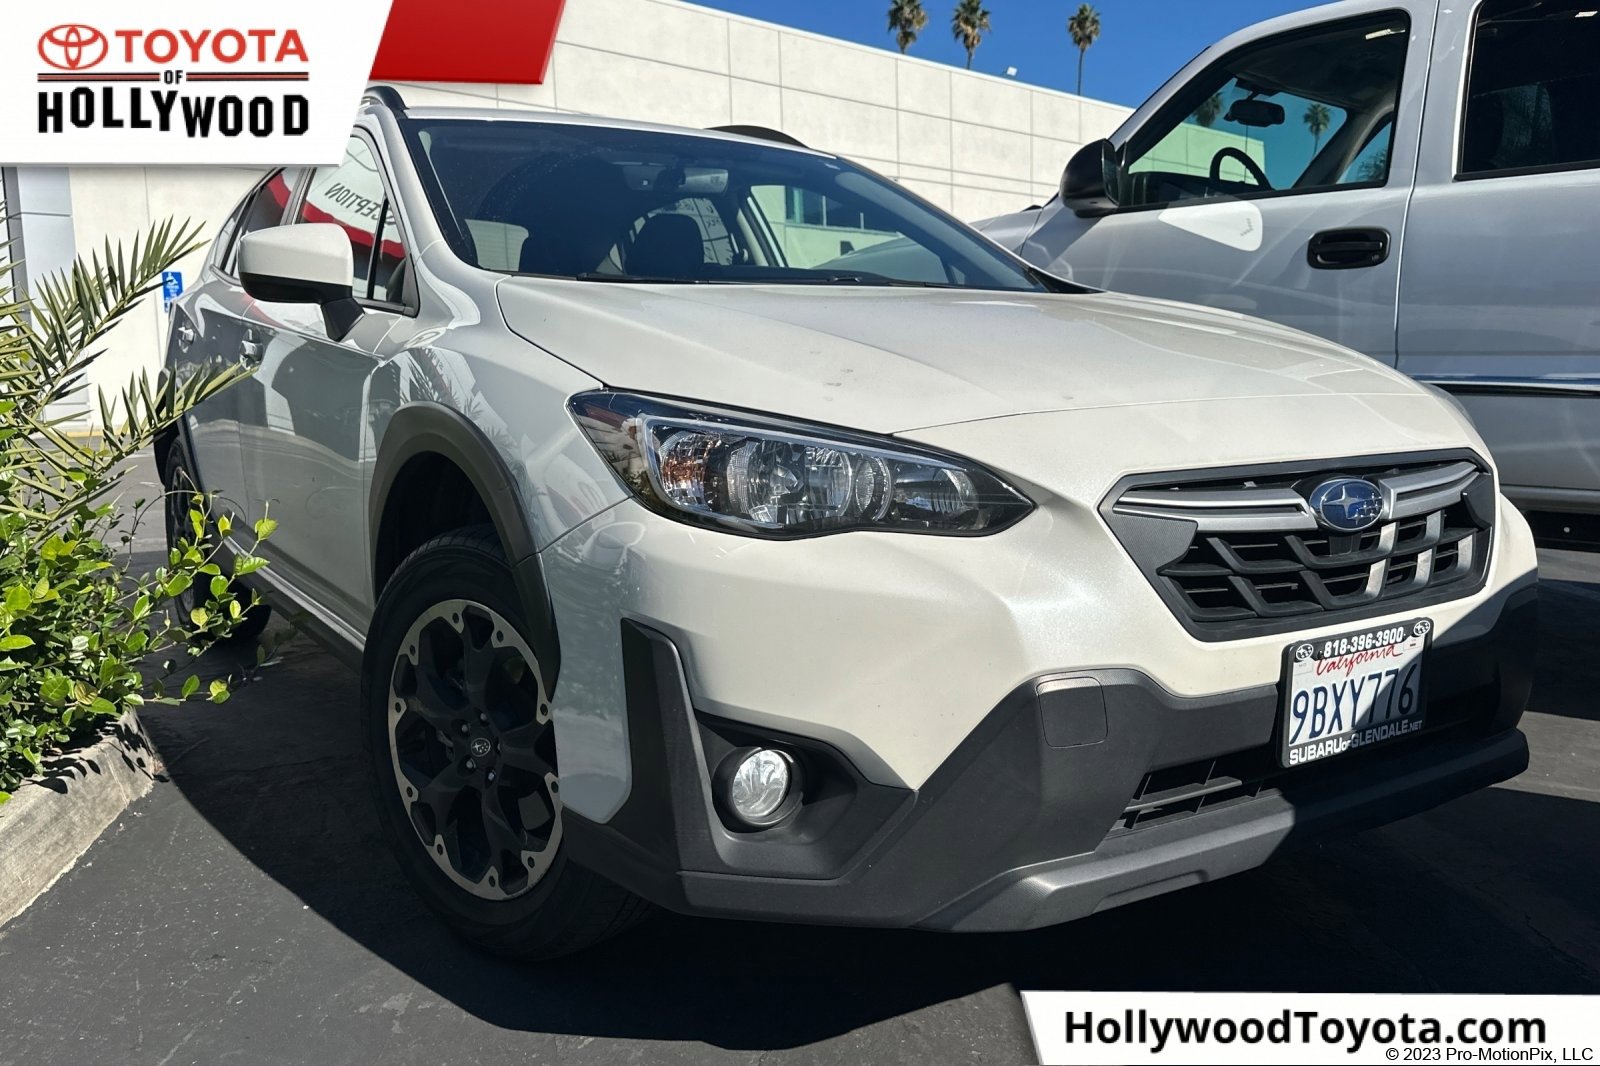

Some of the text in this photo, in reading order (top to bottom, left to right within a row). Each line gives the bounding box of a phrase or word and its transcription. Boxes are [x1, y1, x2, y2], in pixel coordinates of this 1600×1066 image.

[1323, 626, 1404, 658] 818-396-3900
[1316, 643, 1403, 677] California
[1289, 663, 1418, 745] 9BXY776
[1289, 737, 1343, 765] SUBARU
